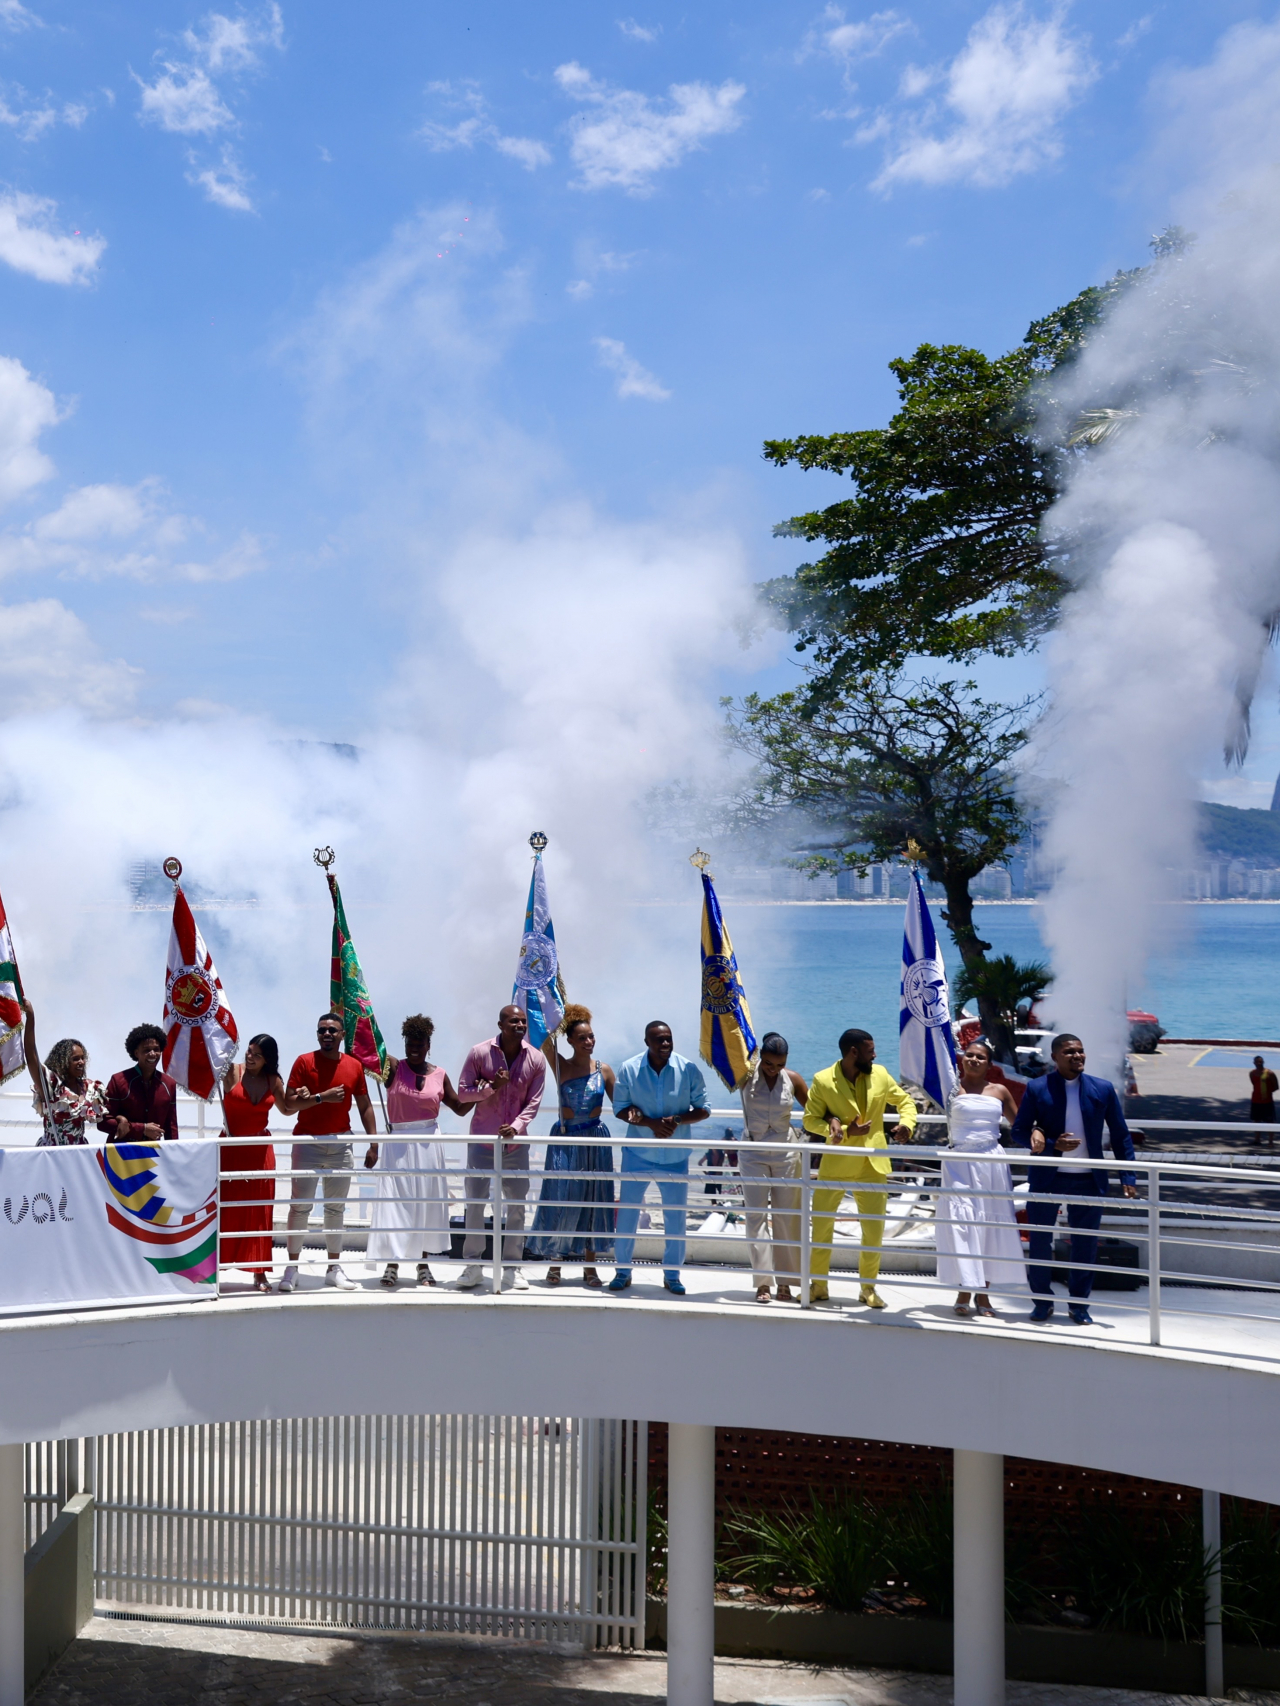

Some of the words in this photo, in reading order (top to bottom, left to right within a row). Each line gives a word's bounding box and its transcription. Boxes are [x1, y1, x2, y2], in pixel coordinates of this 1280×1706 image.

[194, 967, 218, 1012] VIRADOURO
[170, 1008, 199, 1026] UNIDOS
[200, 1011, 212, 1023] DO
